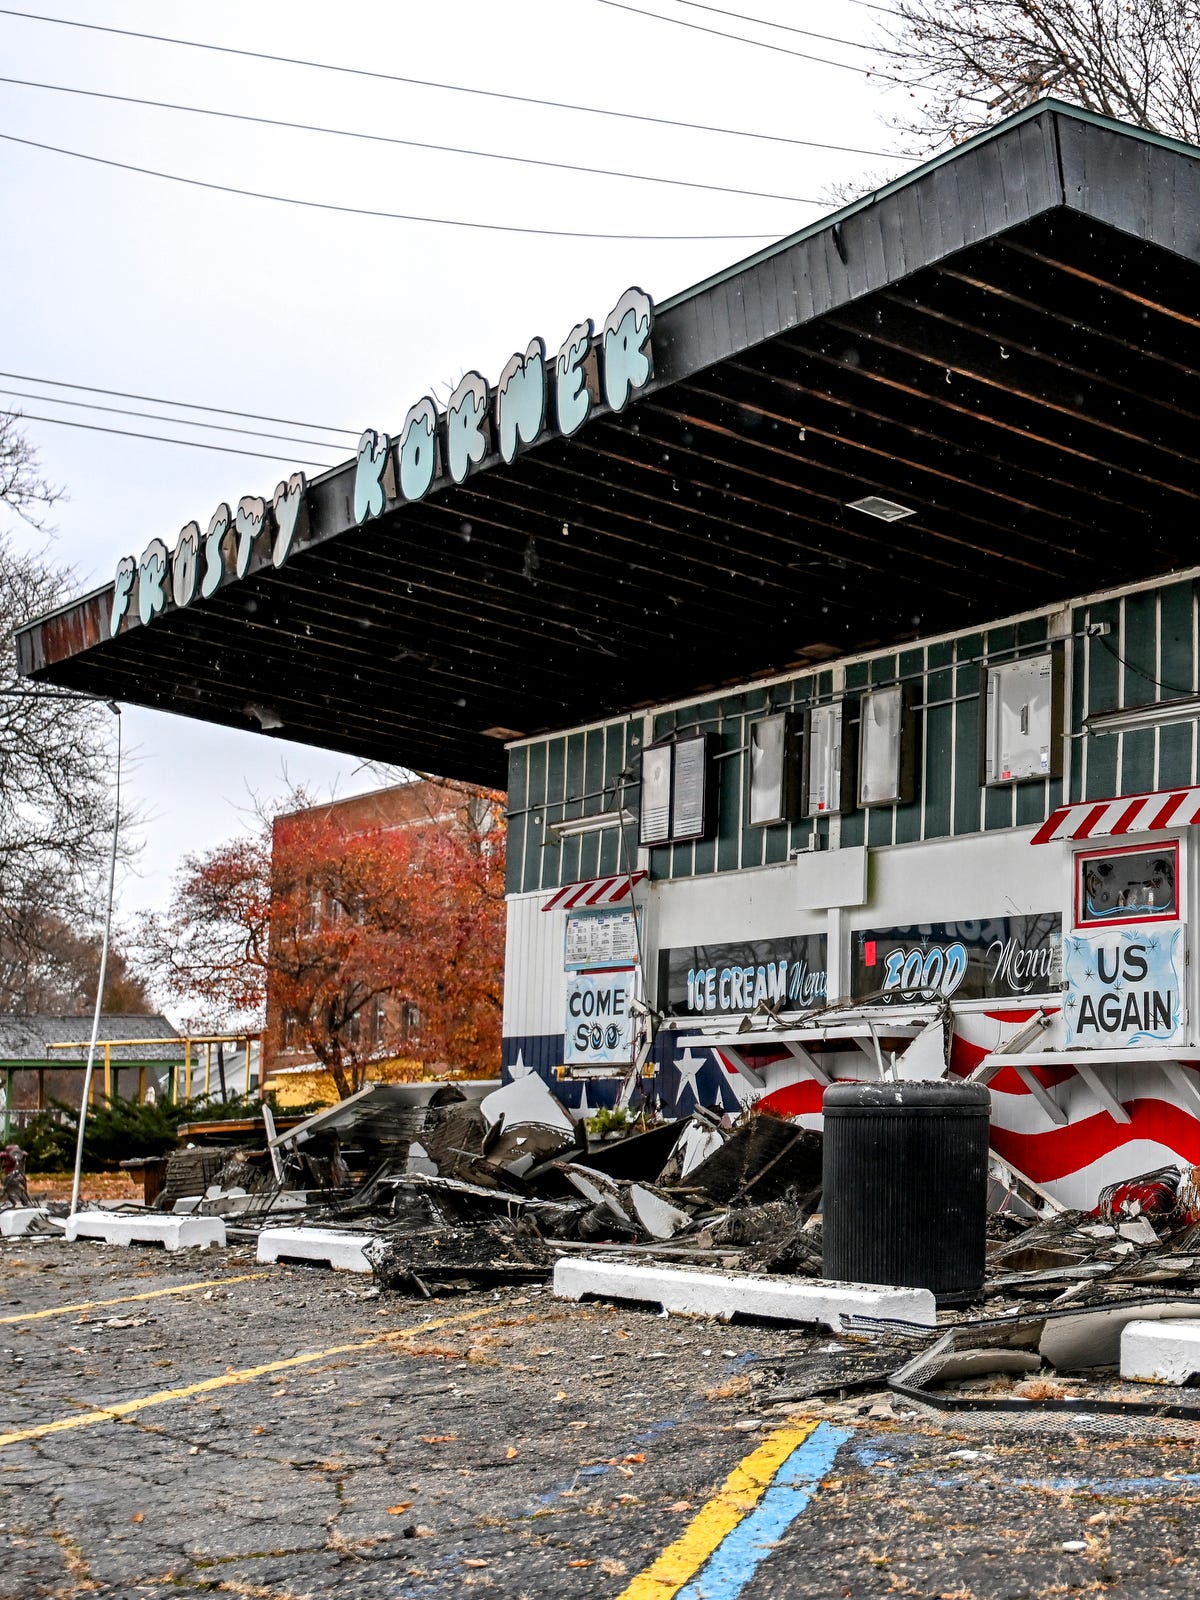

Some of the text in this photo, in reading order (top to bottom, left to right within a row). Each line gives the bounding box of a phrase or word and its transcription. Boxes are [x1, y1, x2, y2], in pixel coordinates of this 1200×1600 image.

[110, 286, 655, 638] FROSTY KORNER
[687, 959, 828, 1011] ICE CREAM Menu
[881, 941, 969, 1003] FOOD
[986, 937, 1056, 992] Menu
[1097, 944, 1149, 985] US
[569, 989, 625, 1018] COME
[1076, 990, 1173, 1034] AGAIN
